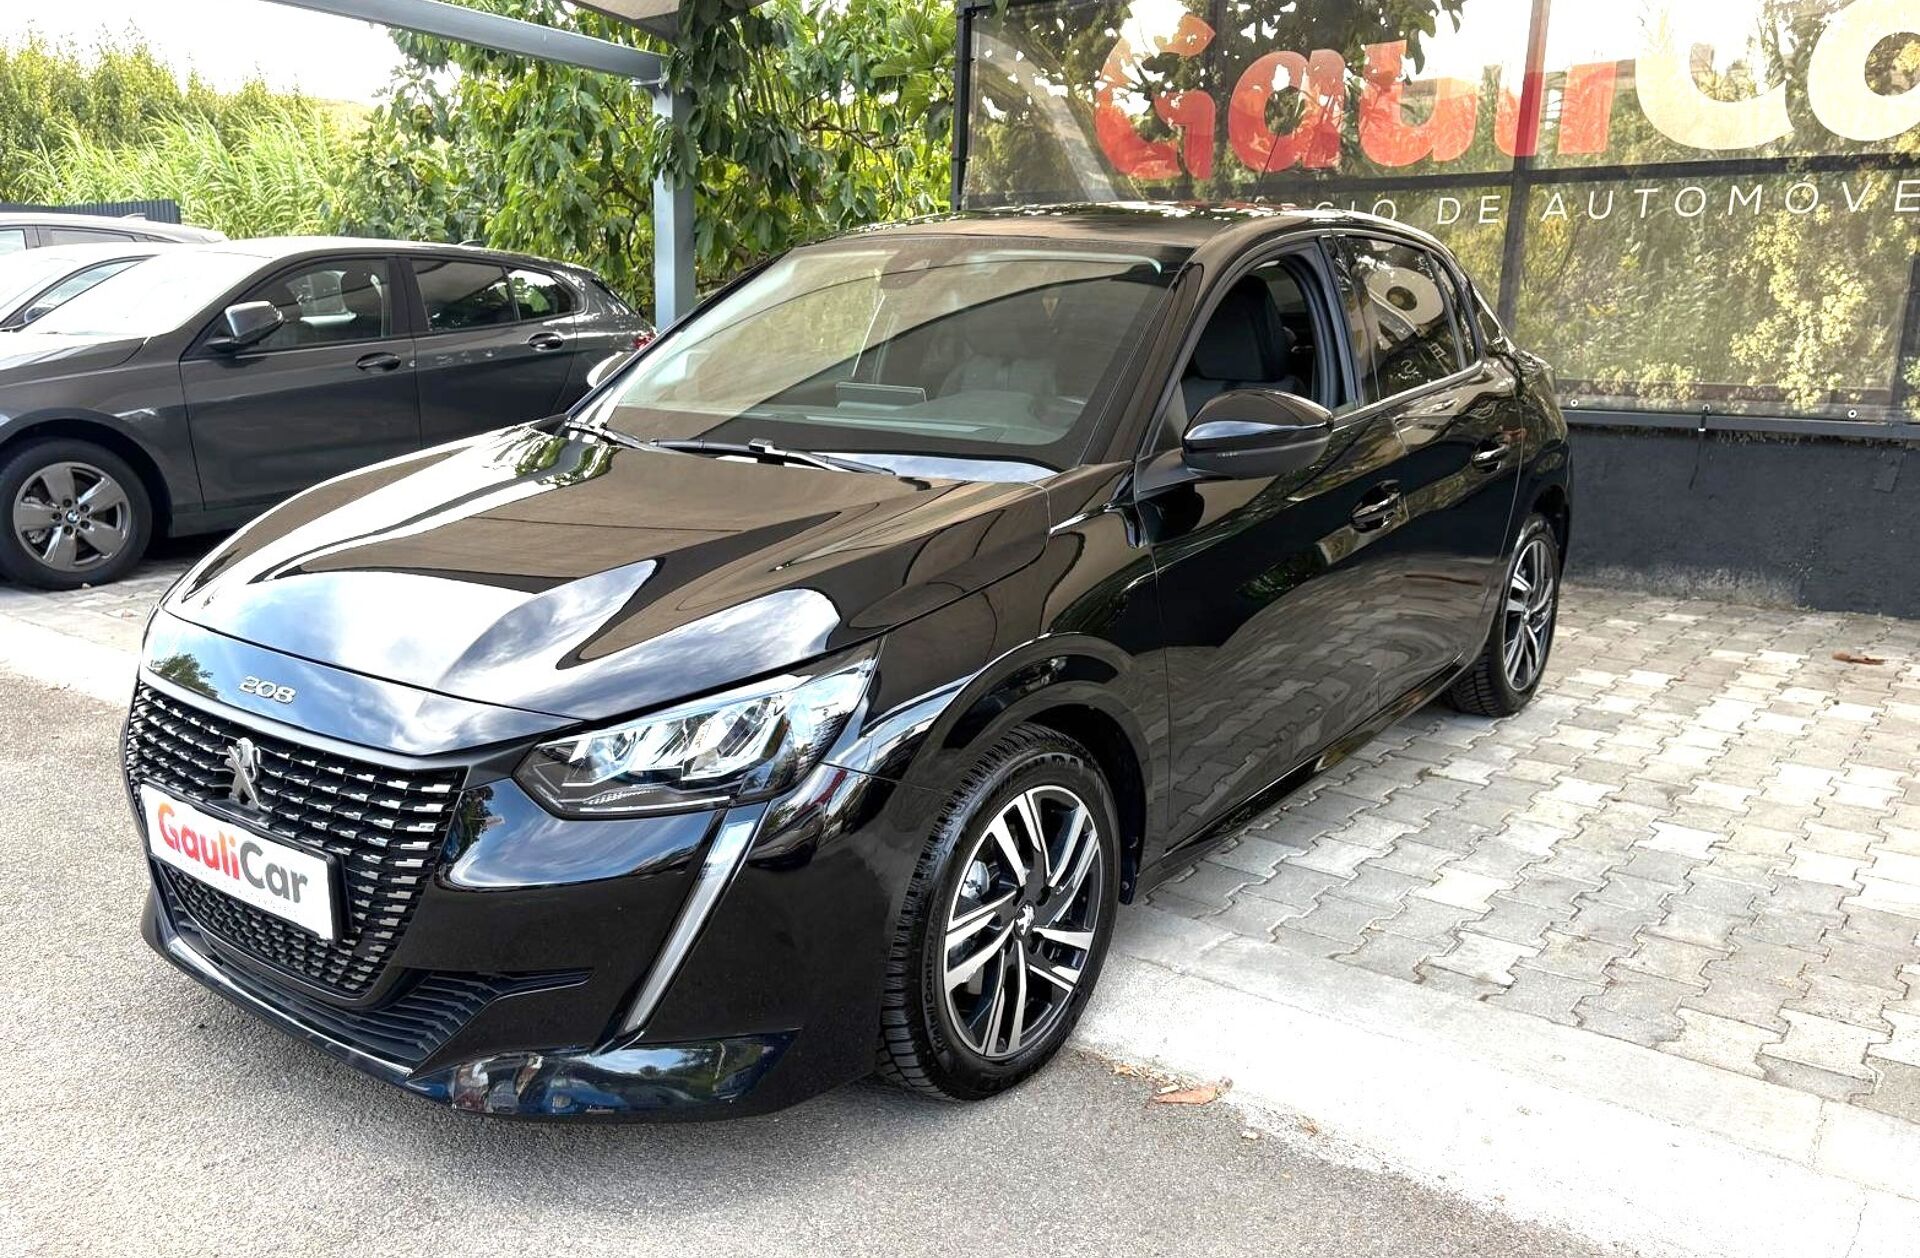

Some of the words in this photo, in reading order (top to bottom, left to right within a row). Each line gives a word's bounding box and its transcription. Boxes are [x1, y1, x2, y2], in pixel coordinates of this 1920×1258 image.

[1437, 195, 1501, 225] DE
[239, 675, 297, 704] 208
[157, 802, 308, 904] GauliCar
